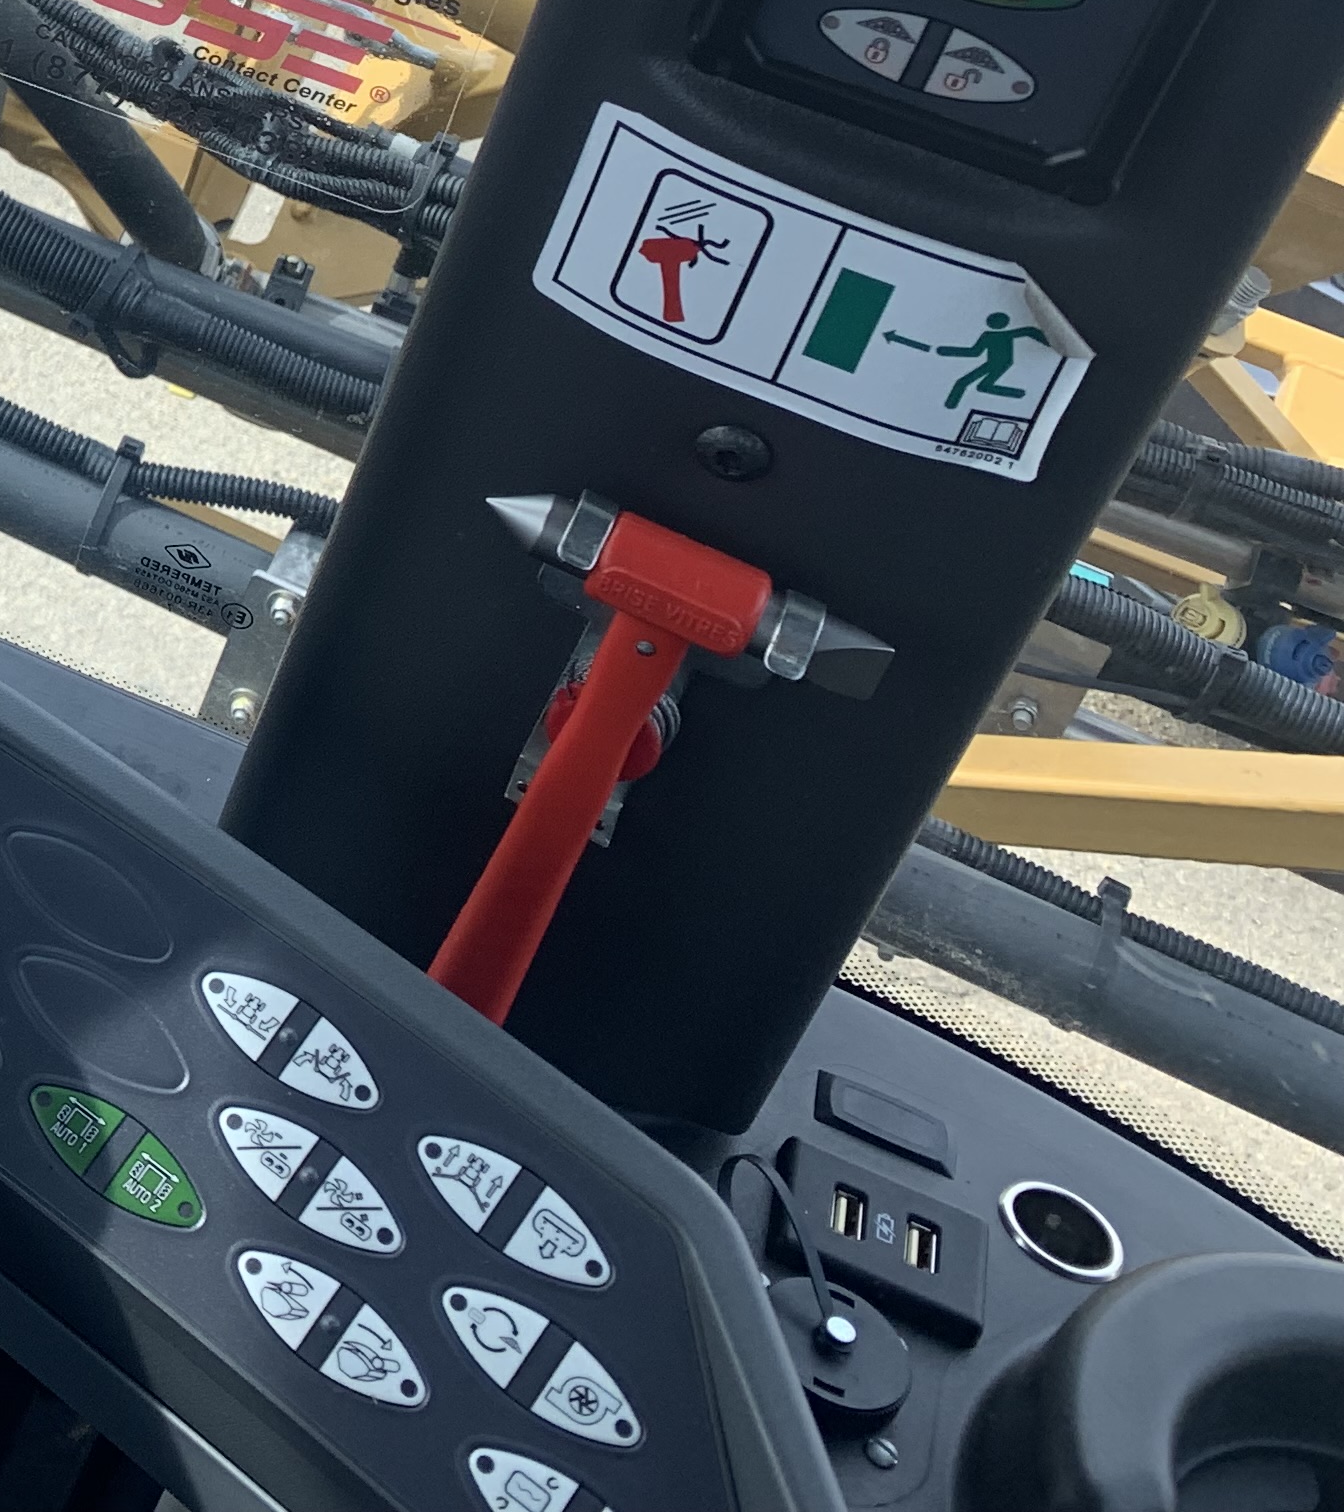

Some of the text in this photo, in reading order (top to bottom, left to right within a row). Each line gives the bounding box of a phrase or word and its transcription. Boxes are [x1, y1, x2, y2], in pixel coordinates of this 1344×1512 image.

[192, 43, 359, 115] Contact Center
[49, 1121, 88, 1154] AUTO 1
[121, 1177, 162, 1213] AUTO 2
